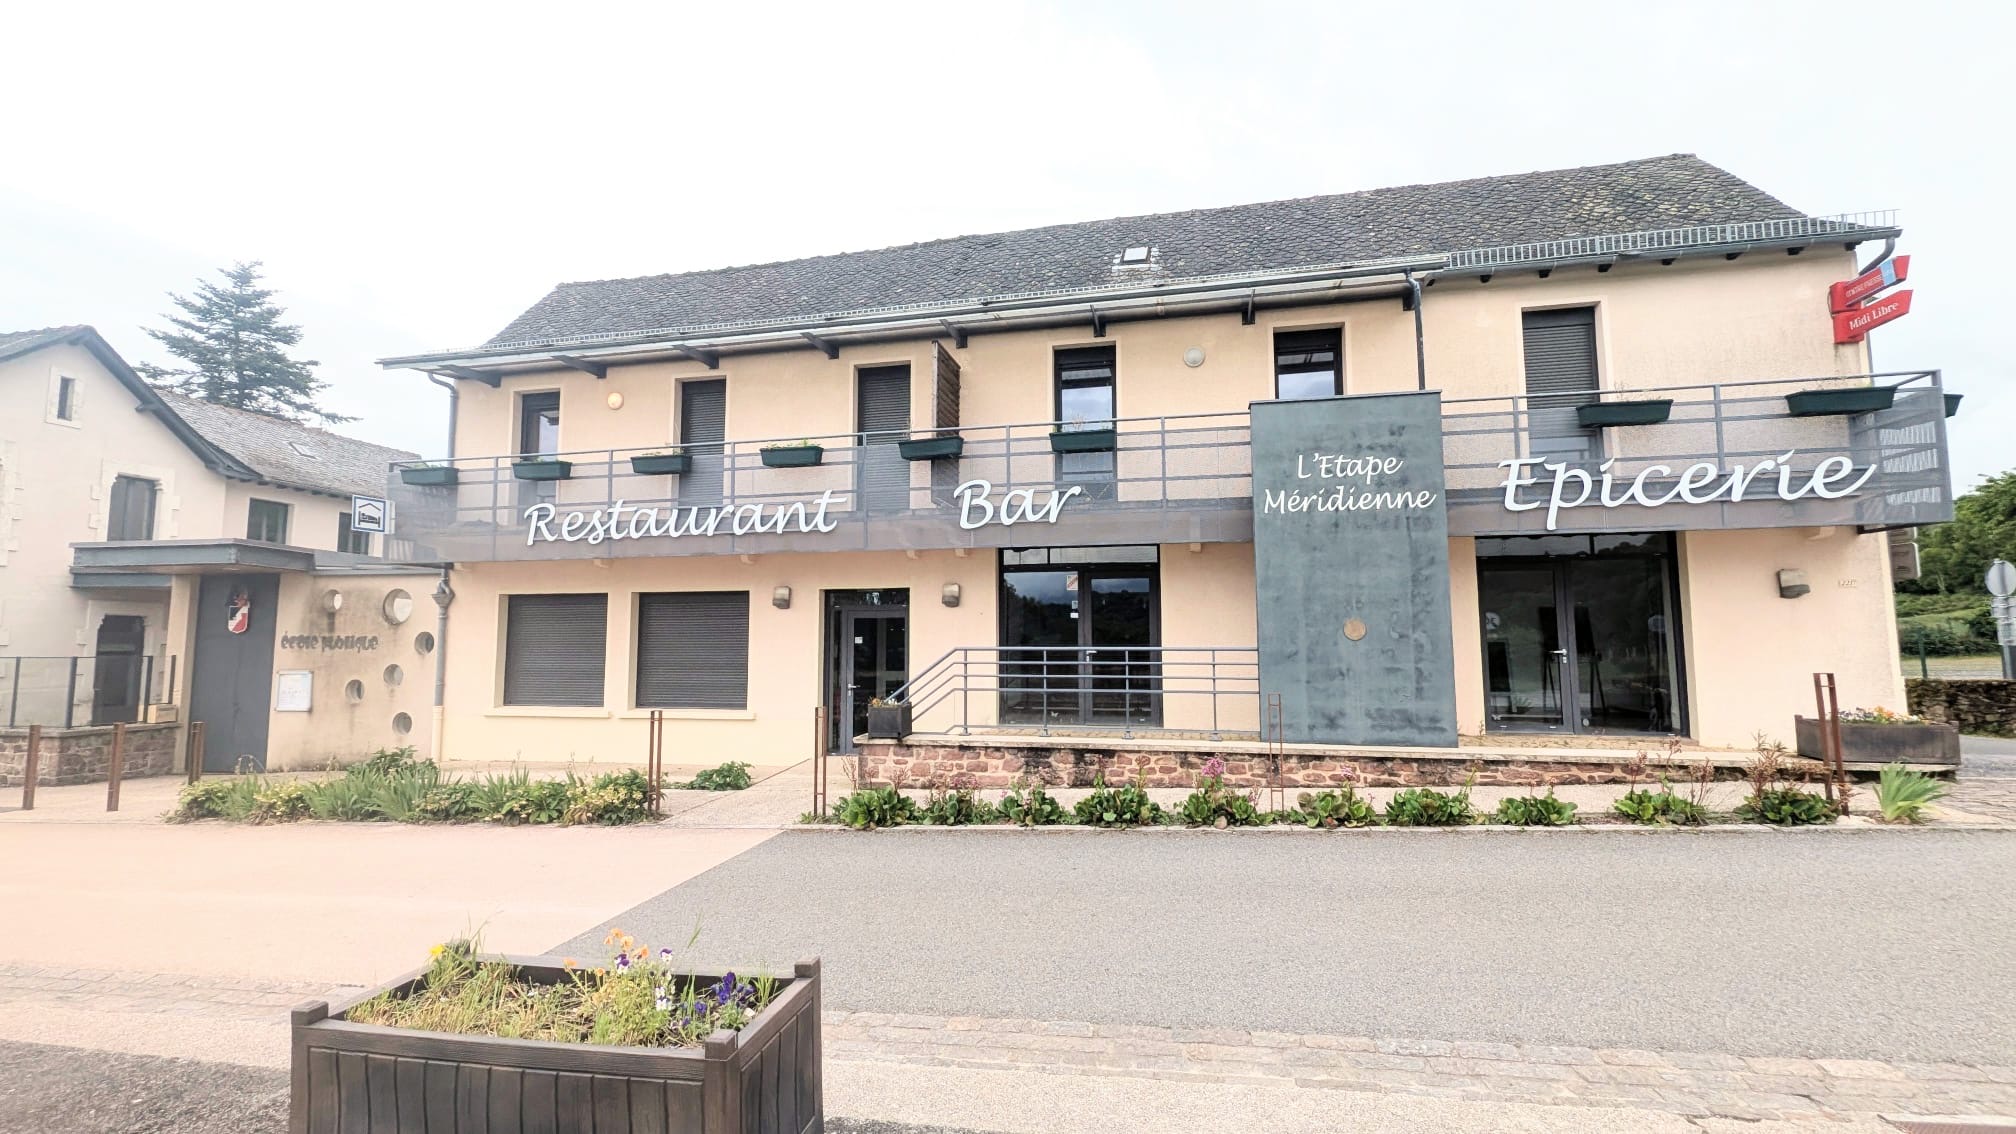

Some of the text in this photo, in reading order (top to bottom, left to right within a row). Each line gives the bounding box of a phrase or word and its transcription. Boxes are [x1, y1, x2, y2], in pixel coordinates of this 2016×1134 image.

[1849, 302, 1899, 330] Midi Libre
[1297, 453, 1404, 485] L'Etape
[953, 479, 1082, 530] Bar
[1264, 485, 1437, 514] Méridienne
[1497, 449, 1878, 531] Epicerie
[524, 489, 848, 546] Restaurant
